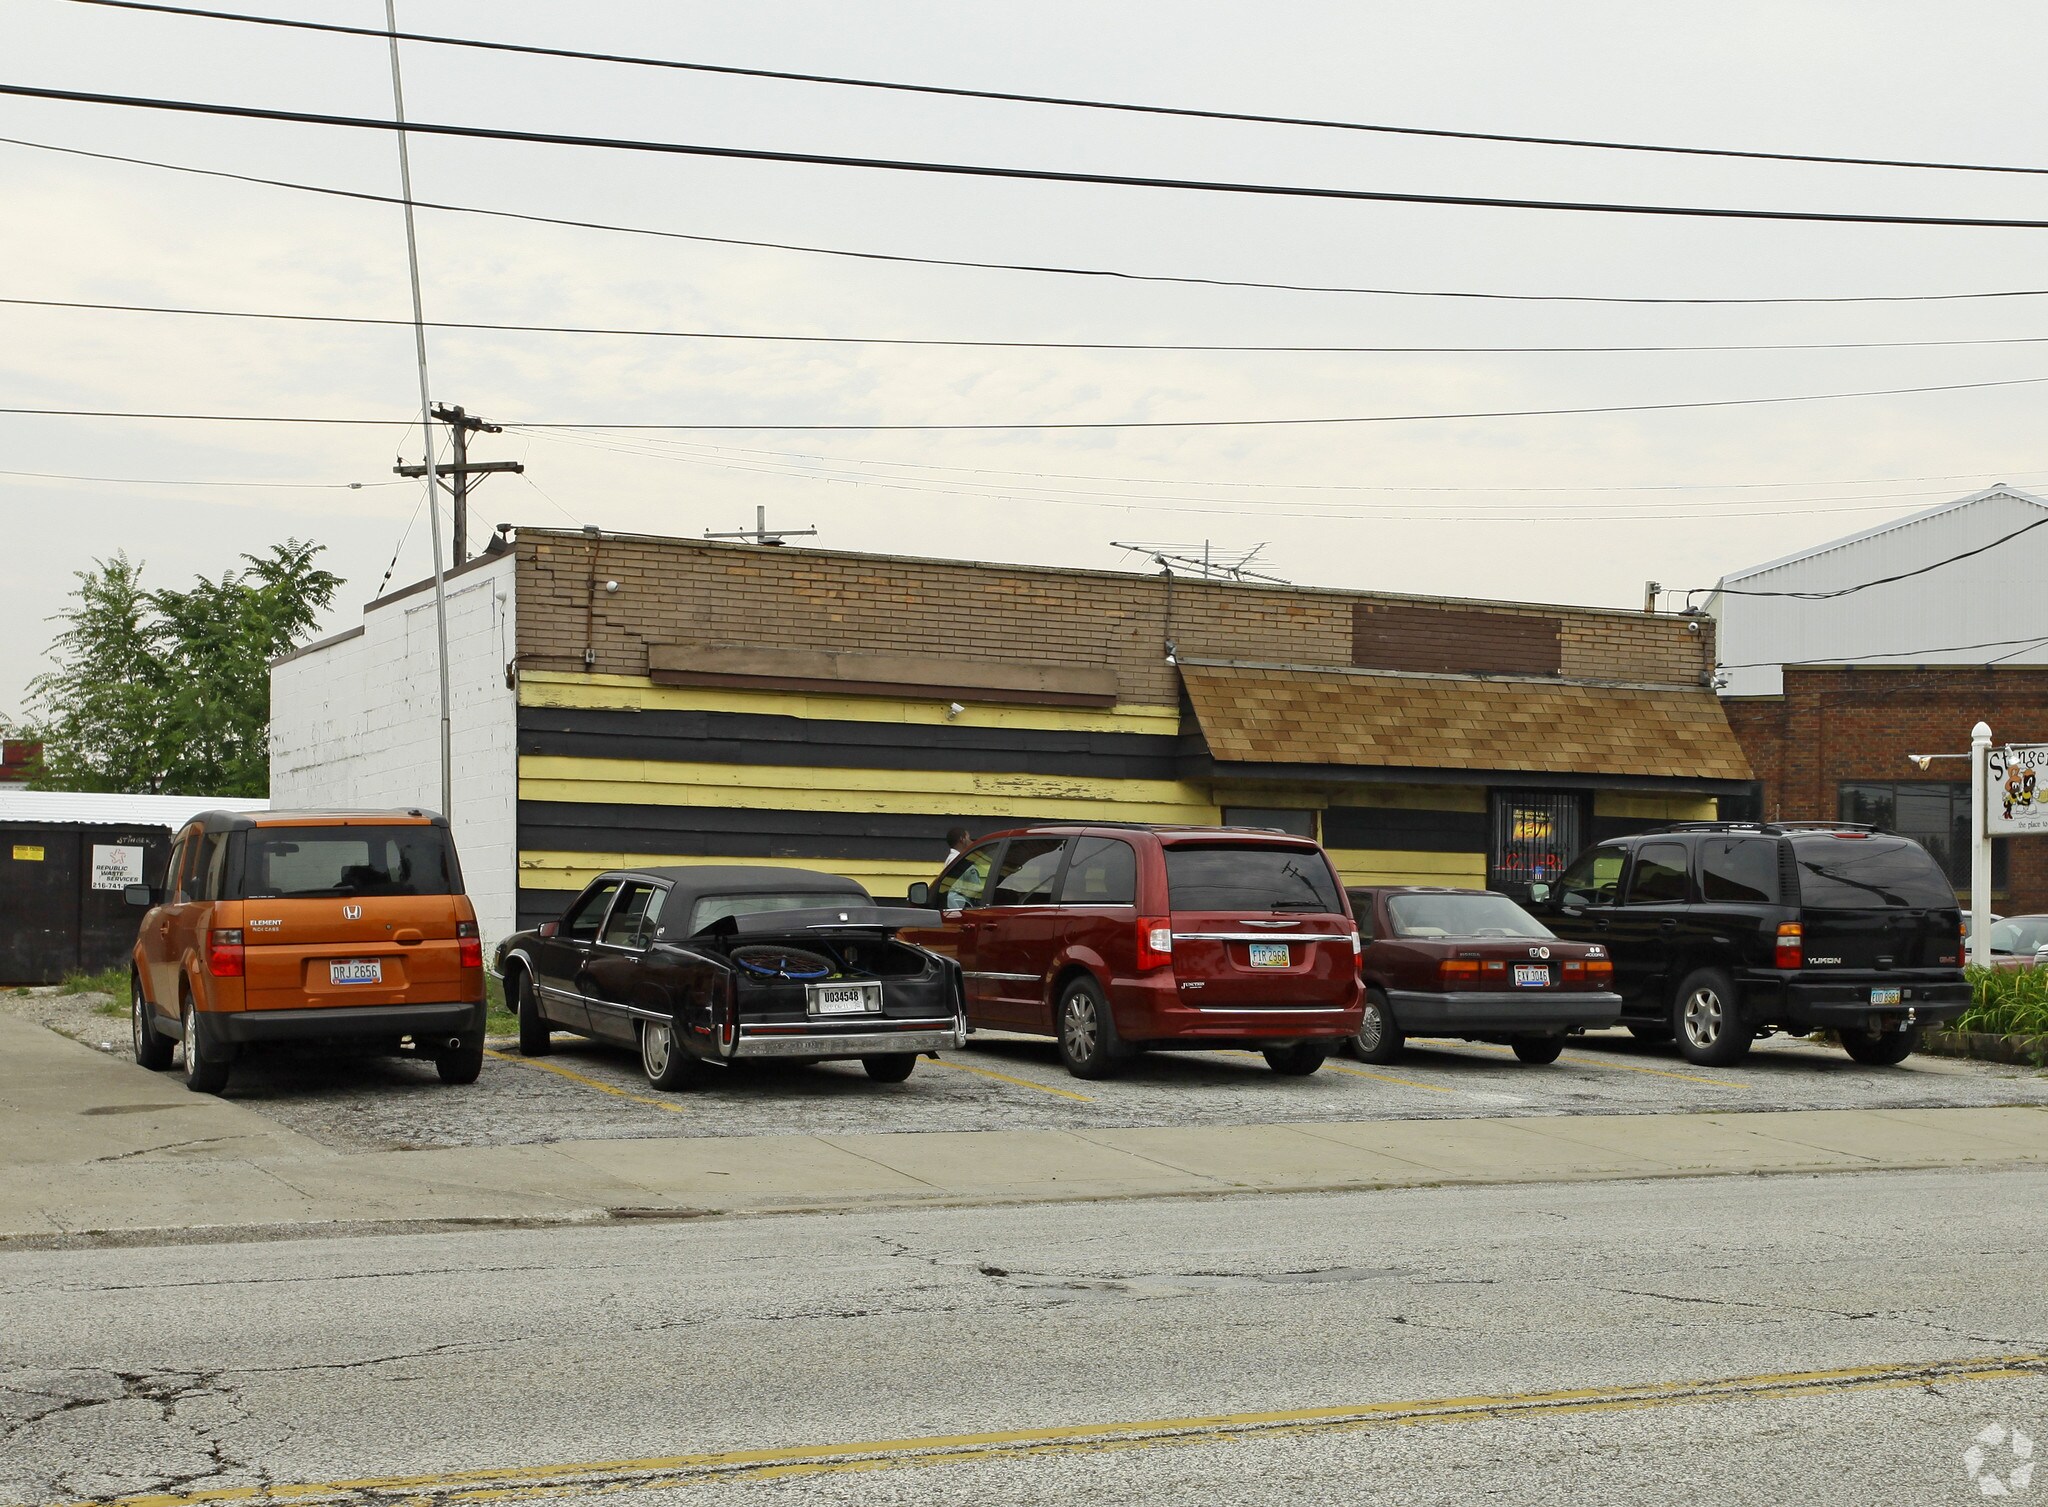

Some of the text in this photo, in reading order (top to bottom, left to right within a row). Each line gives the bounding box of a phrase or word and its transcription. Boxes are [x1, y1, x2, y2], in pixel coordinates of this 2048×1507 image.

[1989, 749, 2048, 781] Stnge
[1269, 950, 1287, 962] 2968
[354, 965, 377, 978] 2656
